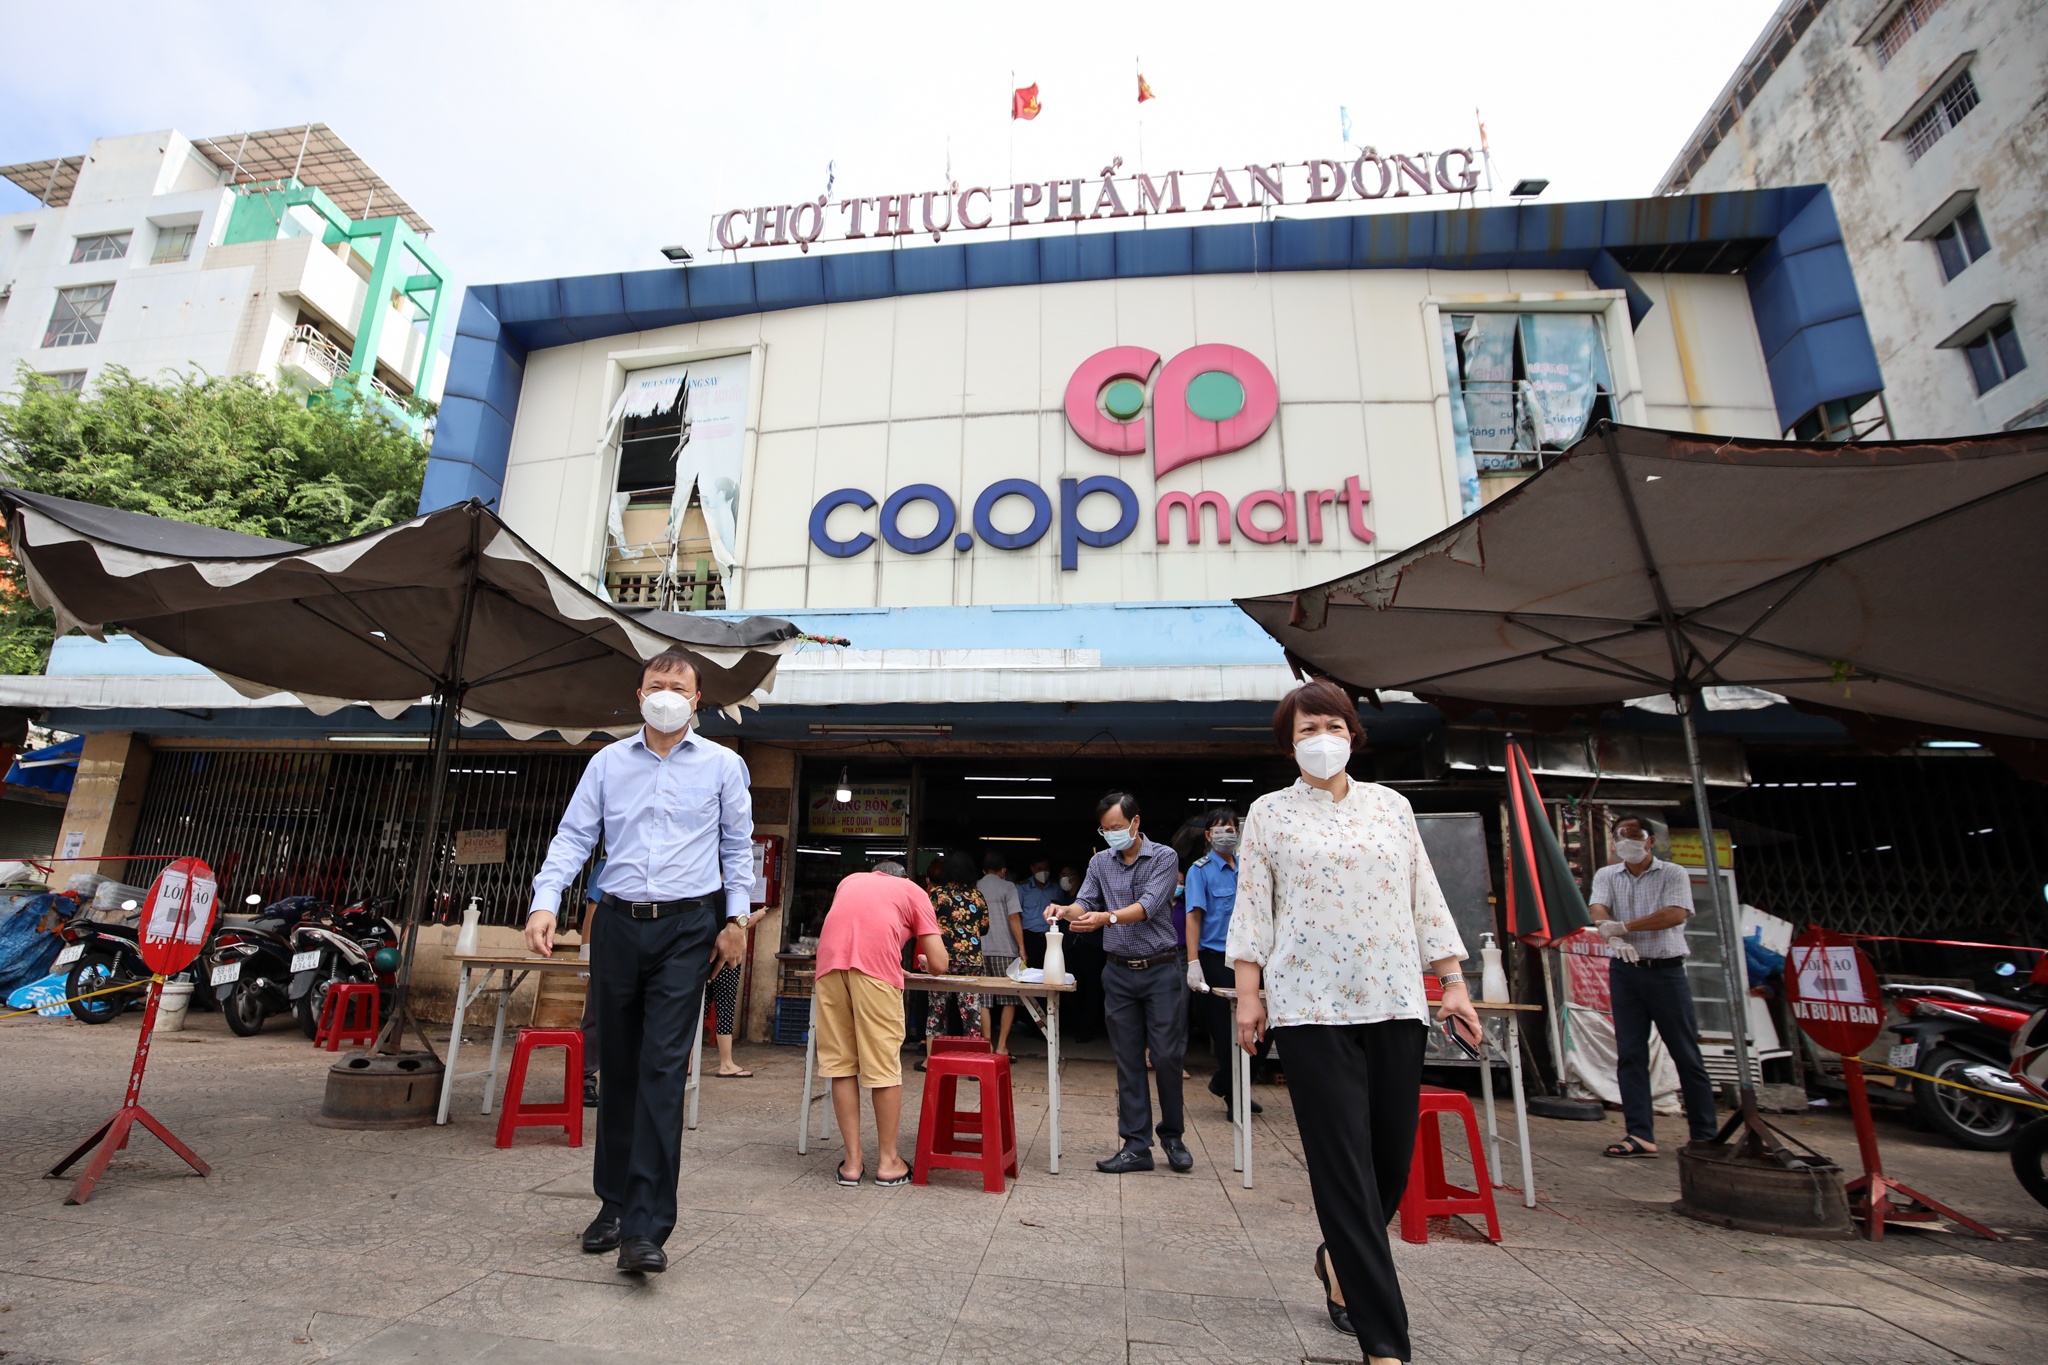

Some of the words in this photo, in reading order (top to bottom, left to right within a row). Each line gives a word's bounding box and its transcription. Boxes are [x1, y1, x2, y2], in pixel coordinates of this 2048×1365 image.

[716, 194, 828, 254] CHỢ
[841, 180, 993, 243] THỰC
[1010, 156, 1186, 225] PHẨM
[1203, 162, 1286, 211] AN
[1303, 146, 1482, 203] ĐÔNG
[1528, 362, 1569, 376] ượng
[809, 474, 1140, 571] co.op
[1156, 474, 1376, 545] mart
